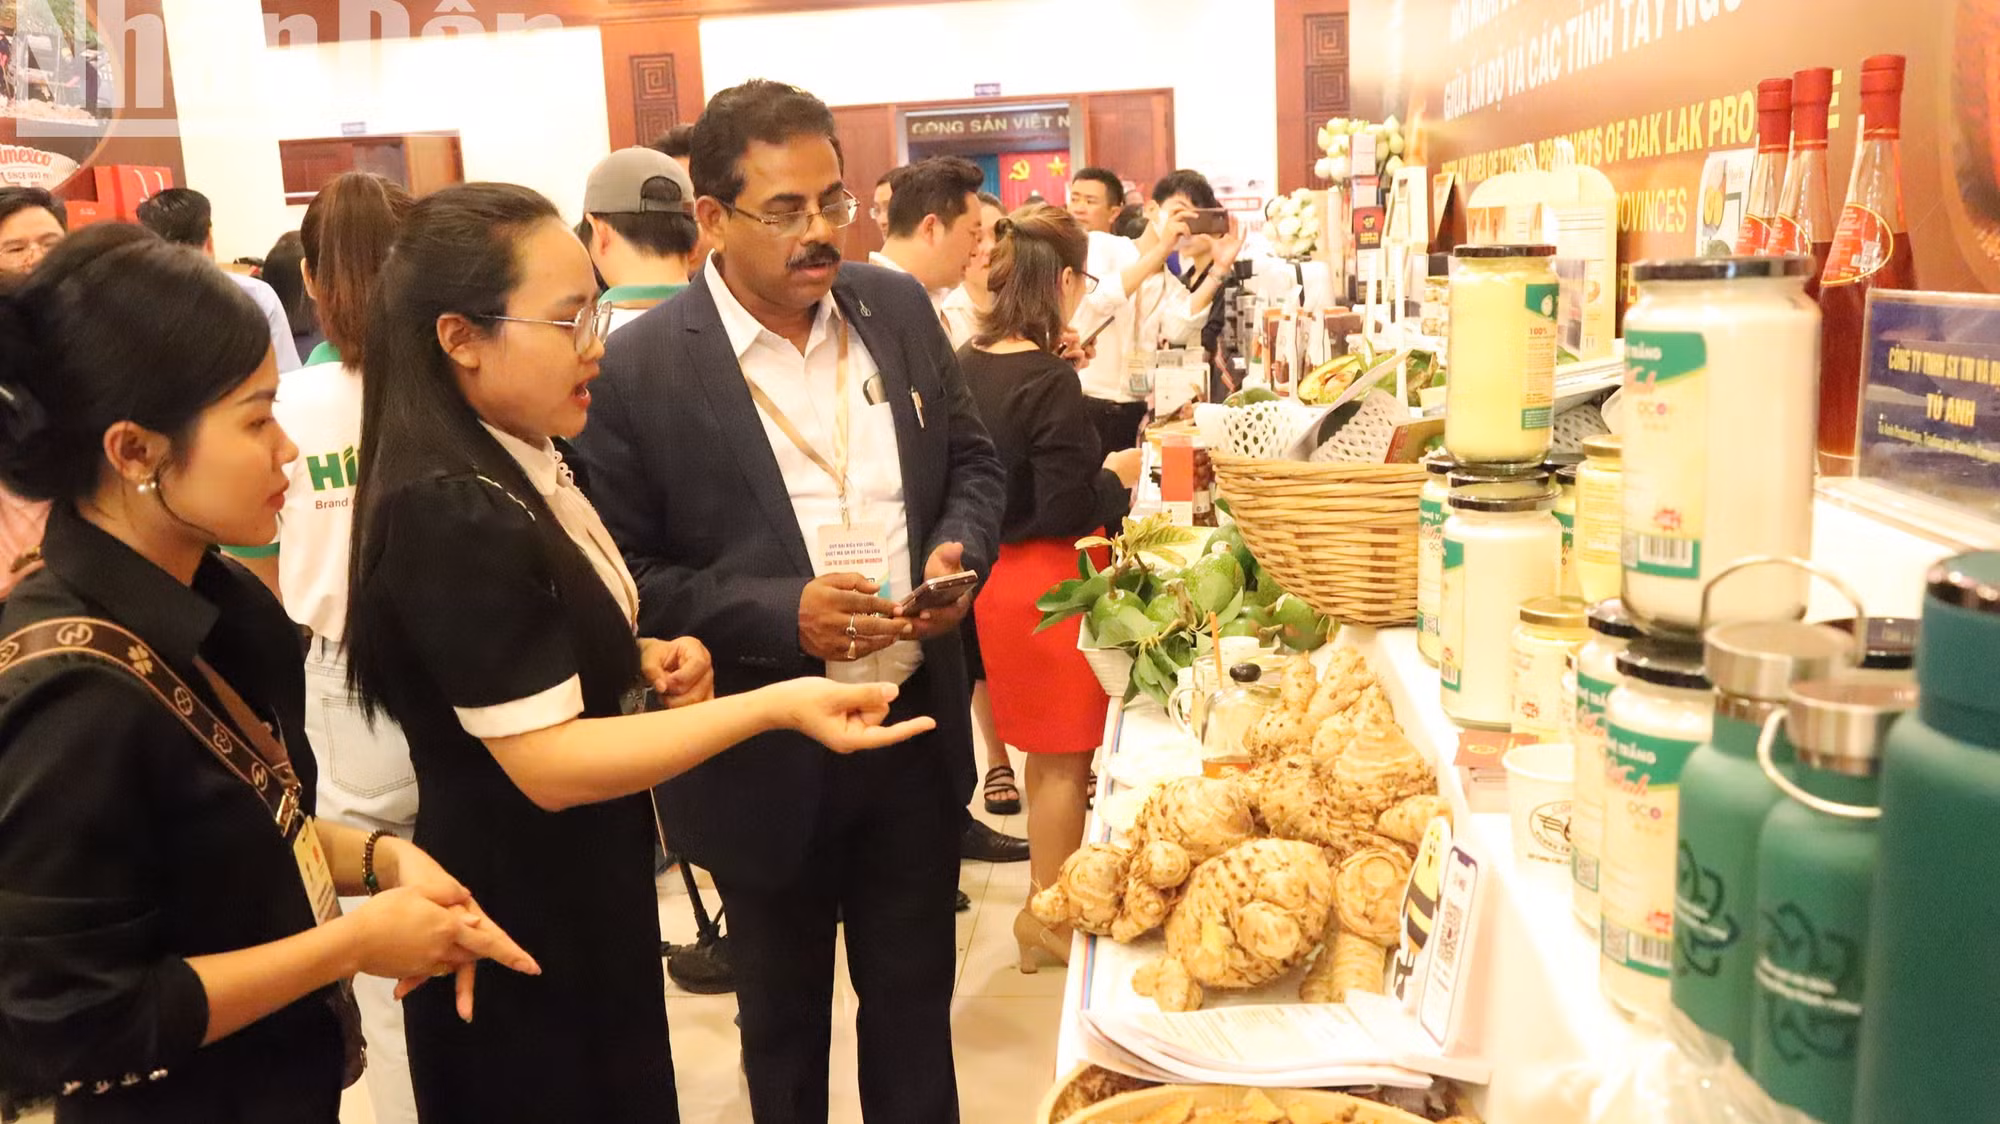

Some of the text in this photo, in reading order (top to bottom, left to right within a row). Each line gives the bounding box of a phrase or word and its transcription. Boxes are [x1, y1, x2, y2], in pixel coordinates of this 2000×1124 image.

[1527, 20, 1562, 89] CÁC
[1605, 121, 1626, 164] OF
[1627, 111, 1662, 160] DAK
[1665, 101, 1705, 154] LAK
[1944, 397, 1976, 428] ANH
[315, 497, 349, 510] Brand
